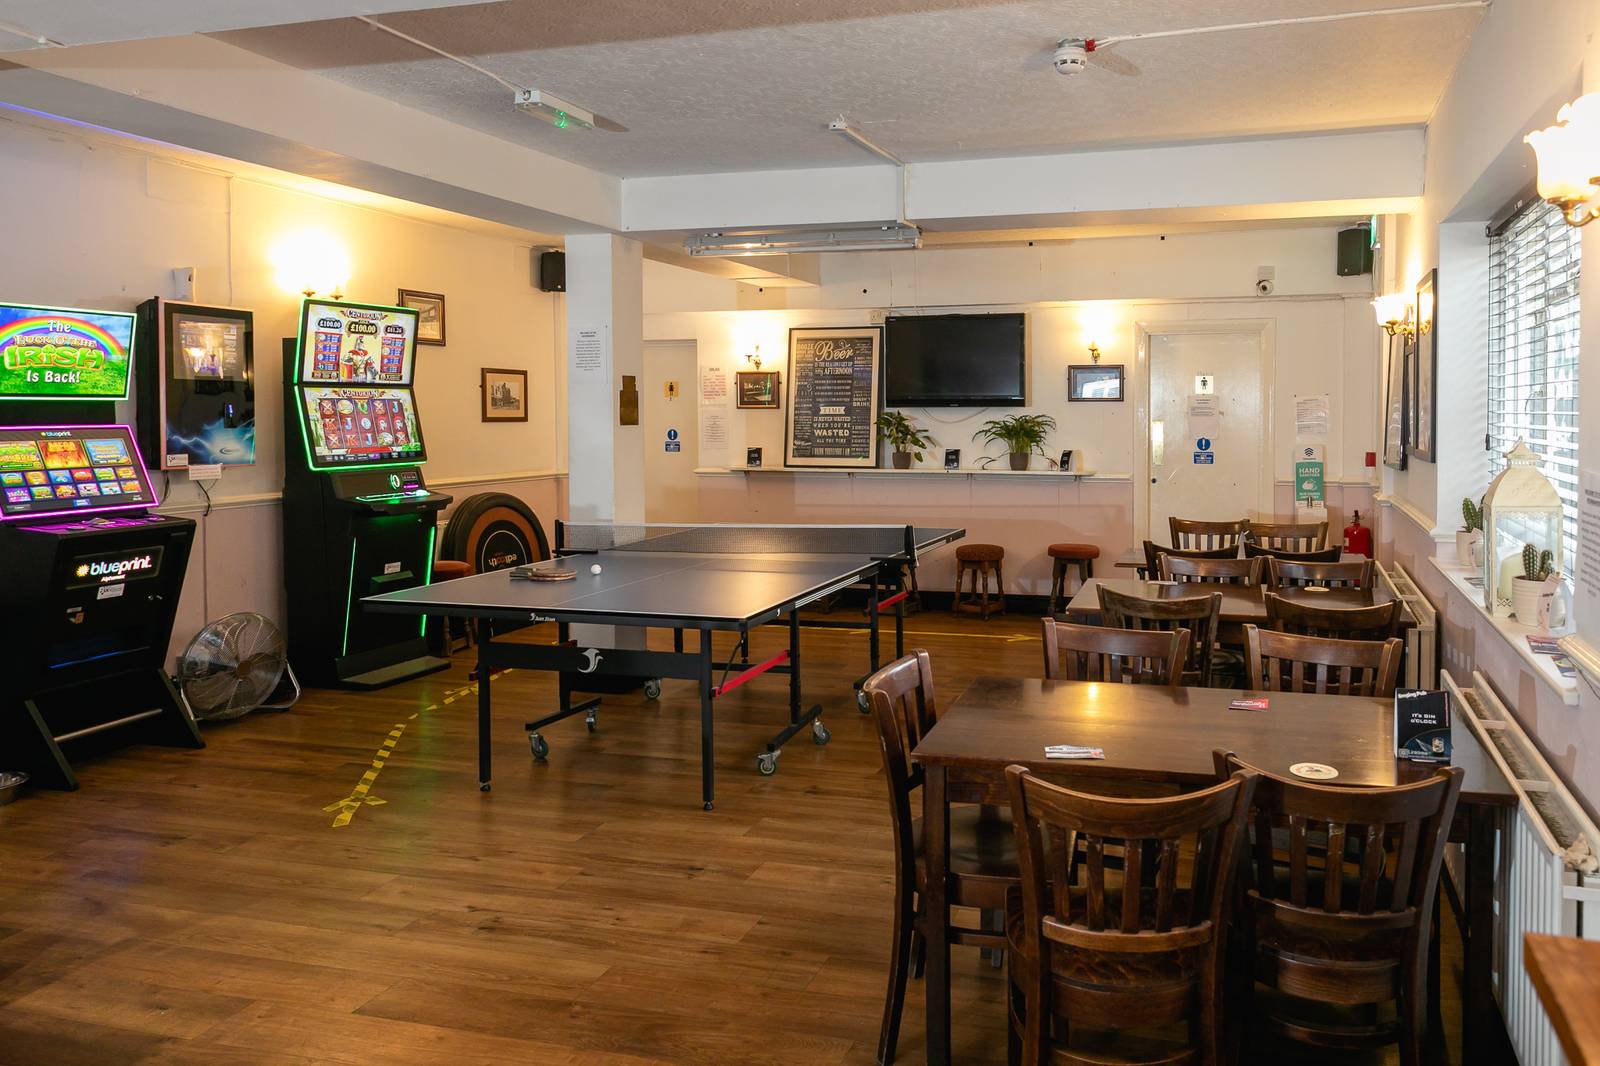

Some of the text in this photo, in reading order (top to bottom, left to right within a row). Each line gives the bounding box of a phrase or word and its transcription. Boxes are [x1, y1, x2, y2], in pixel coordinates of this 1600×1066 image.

[47, 320, 71, 333] The
[350, 324, 376, 333] £100.00
[4, 345, 104, 370] IRISH
[815, 340, 854, 362] Beer
[26, 370, 80, 383] Is Back!
[90, 556, 152, 575] blueprint
